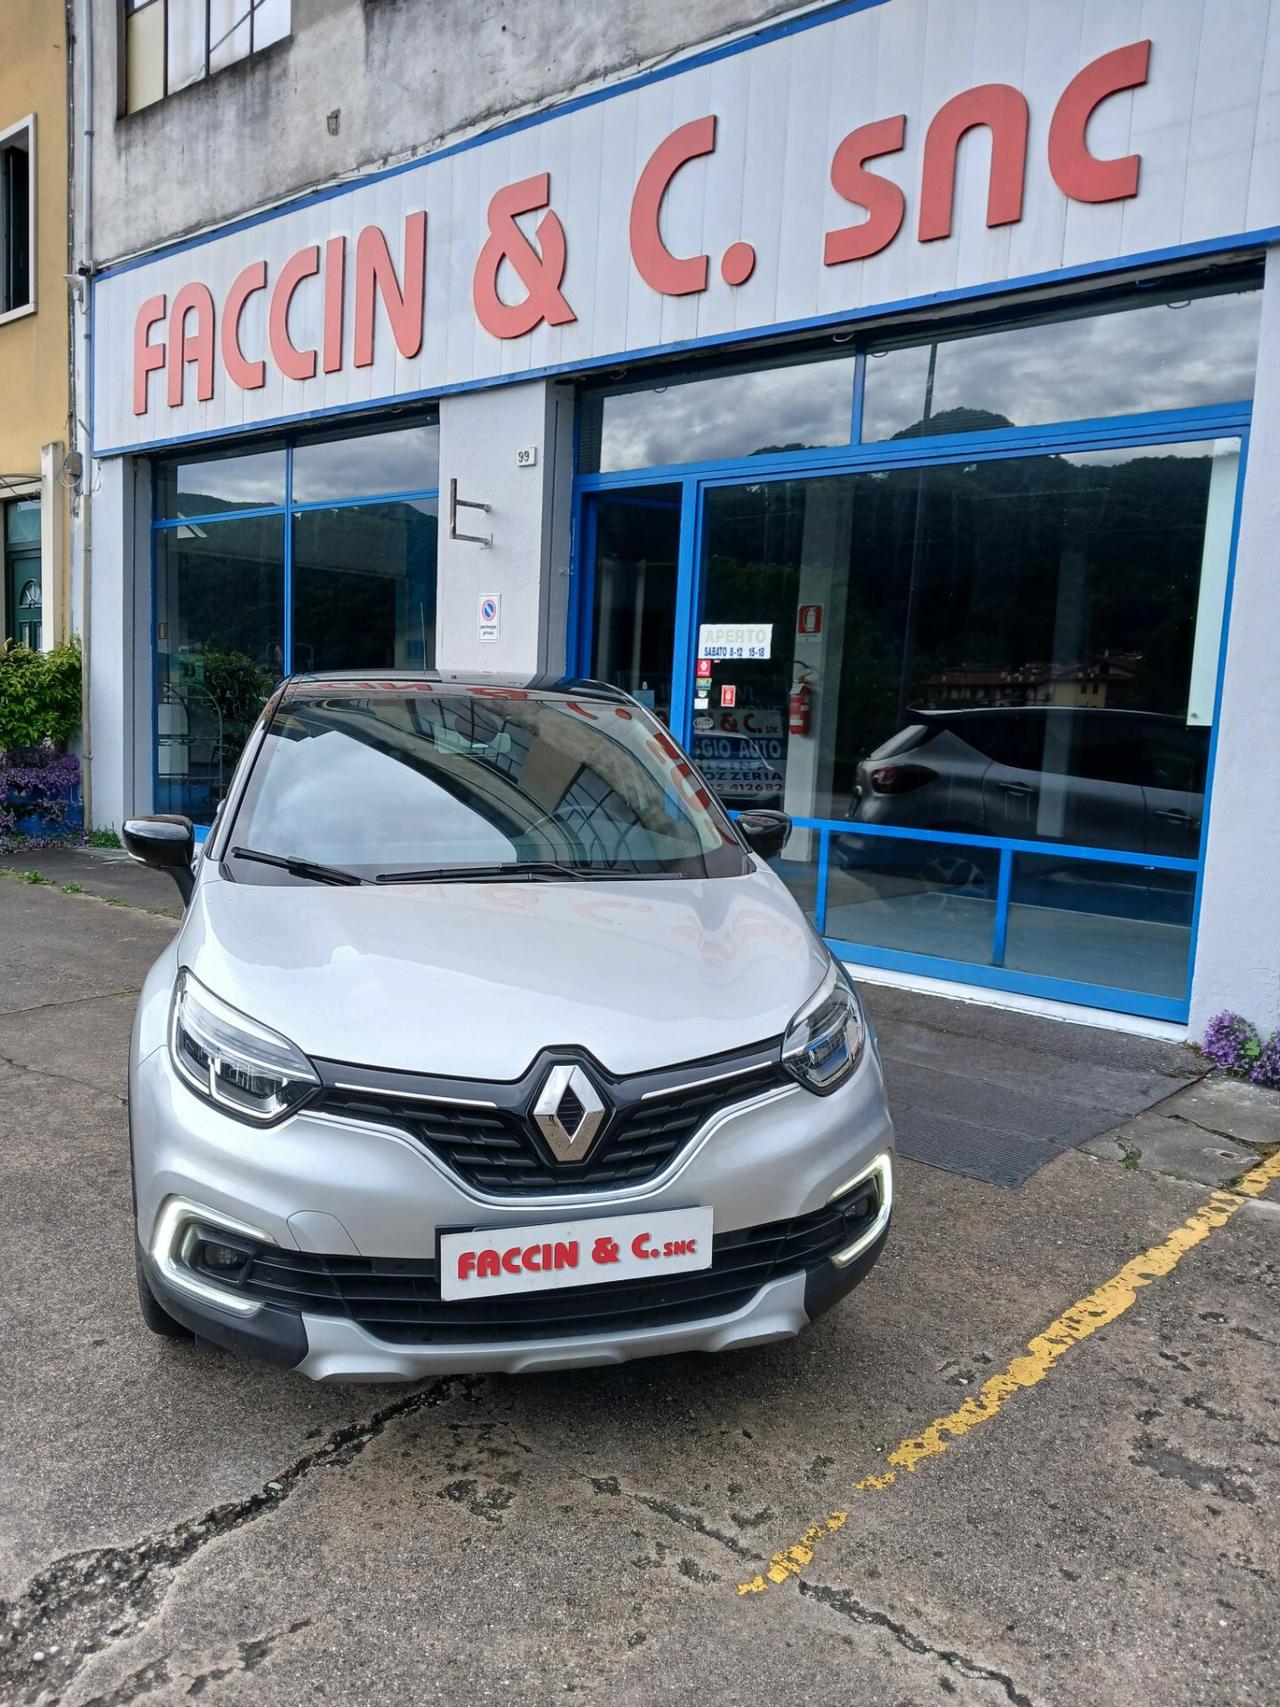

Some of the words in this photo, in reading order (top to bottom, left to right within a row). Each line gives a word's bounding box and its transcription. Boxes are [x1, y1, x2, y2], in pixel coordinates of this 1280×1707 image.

[133, 210, 427, 416] FACCIN
[473, 172, 577, 339] &
[629, 114, 756, 296] C.
[518, 450, 530, 463] 99
[705, 629, 767, 644] APERTO
[704, 647, 727, 657] SABATO
[739, 738, 781, 758] AUTO
[457, 1240, 579, 1280] FACCIN
[591, 1236, 620, 1265] &
